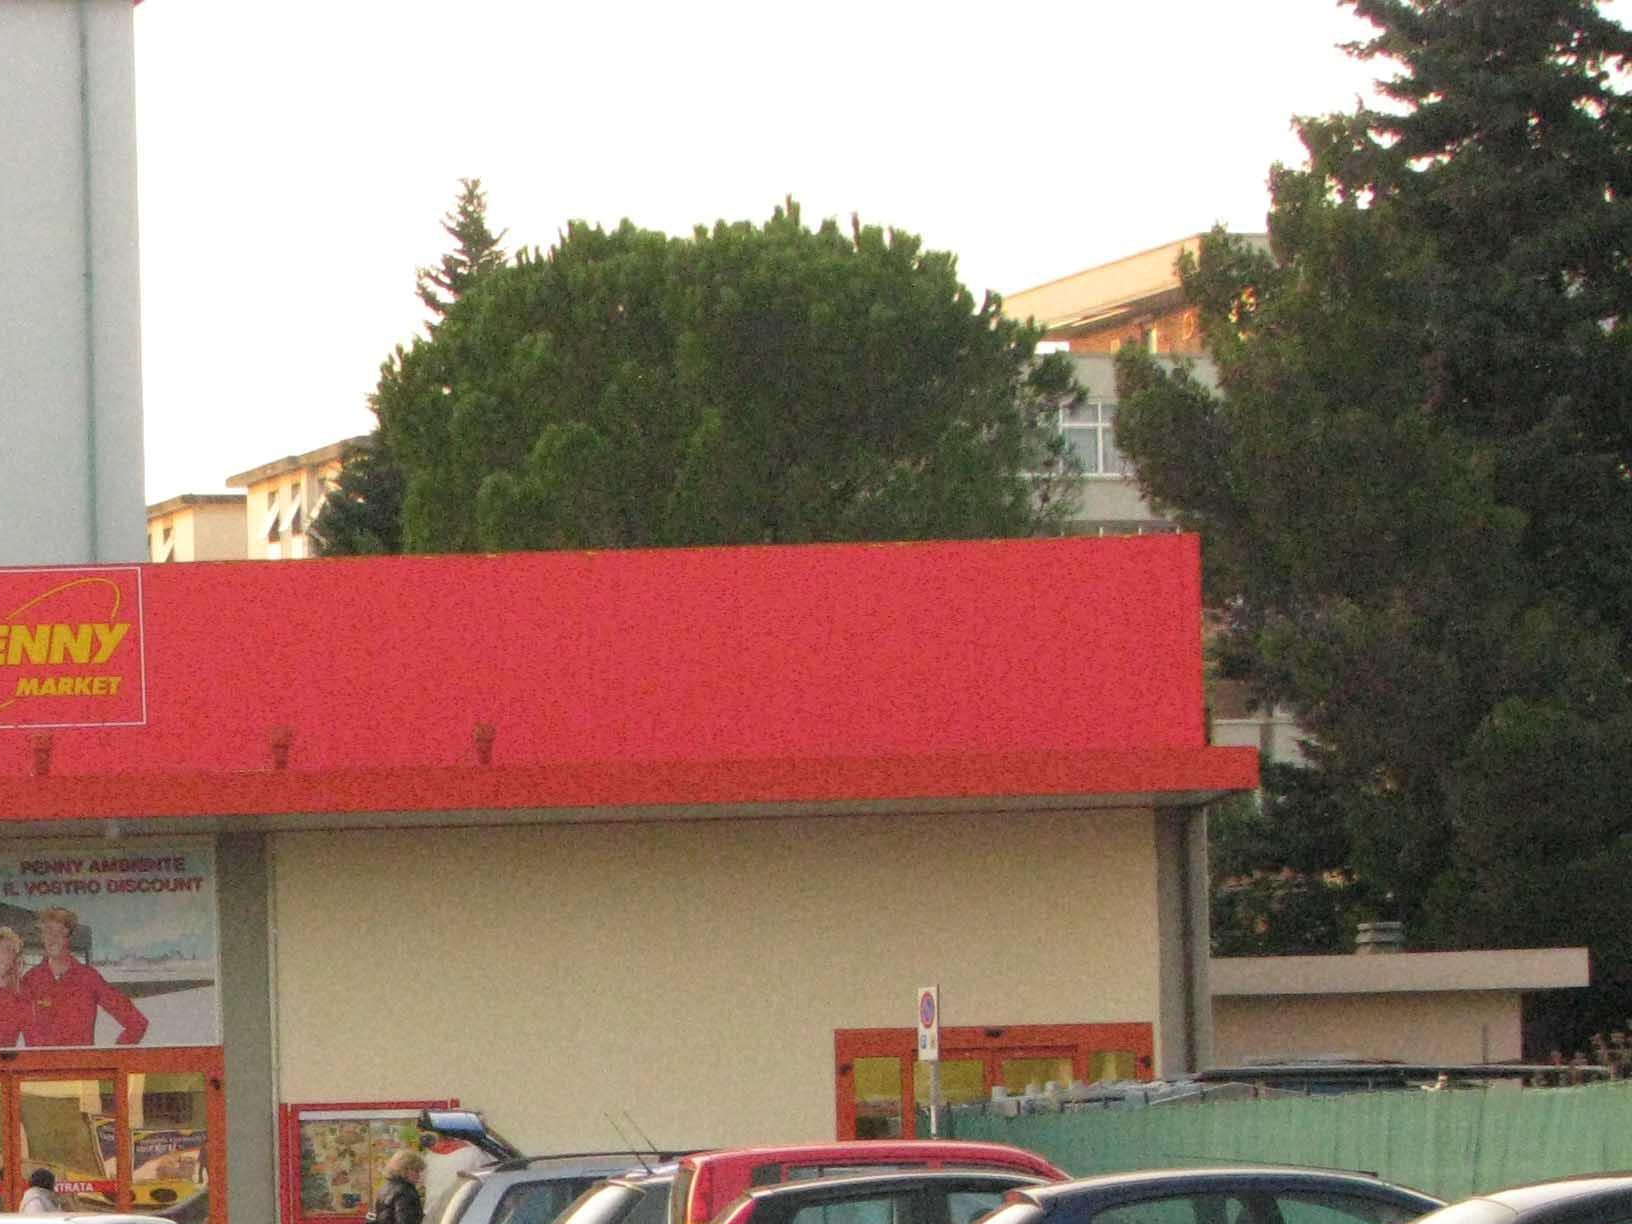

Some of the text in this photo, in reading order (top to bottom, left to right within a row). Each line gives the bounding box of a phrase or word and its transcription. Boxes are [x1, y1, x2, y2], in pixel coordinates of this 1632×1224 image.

[16, 676, 122, 697] MARKET
[20, 858, 83, 875] PENNY
[25, 879, 101, 896] VOSTRO
[106, 877, 204, 895] DISCOUNT
[54, 1181, 94, 1193] NTRATA
